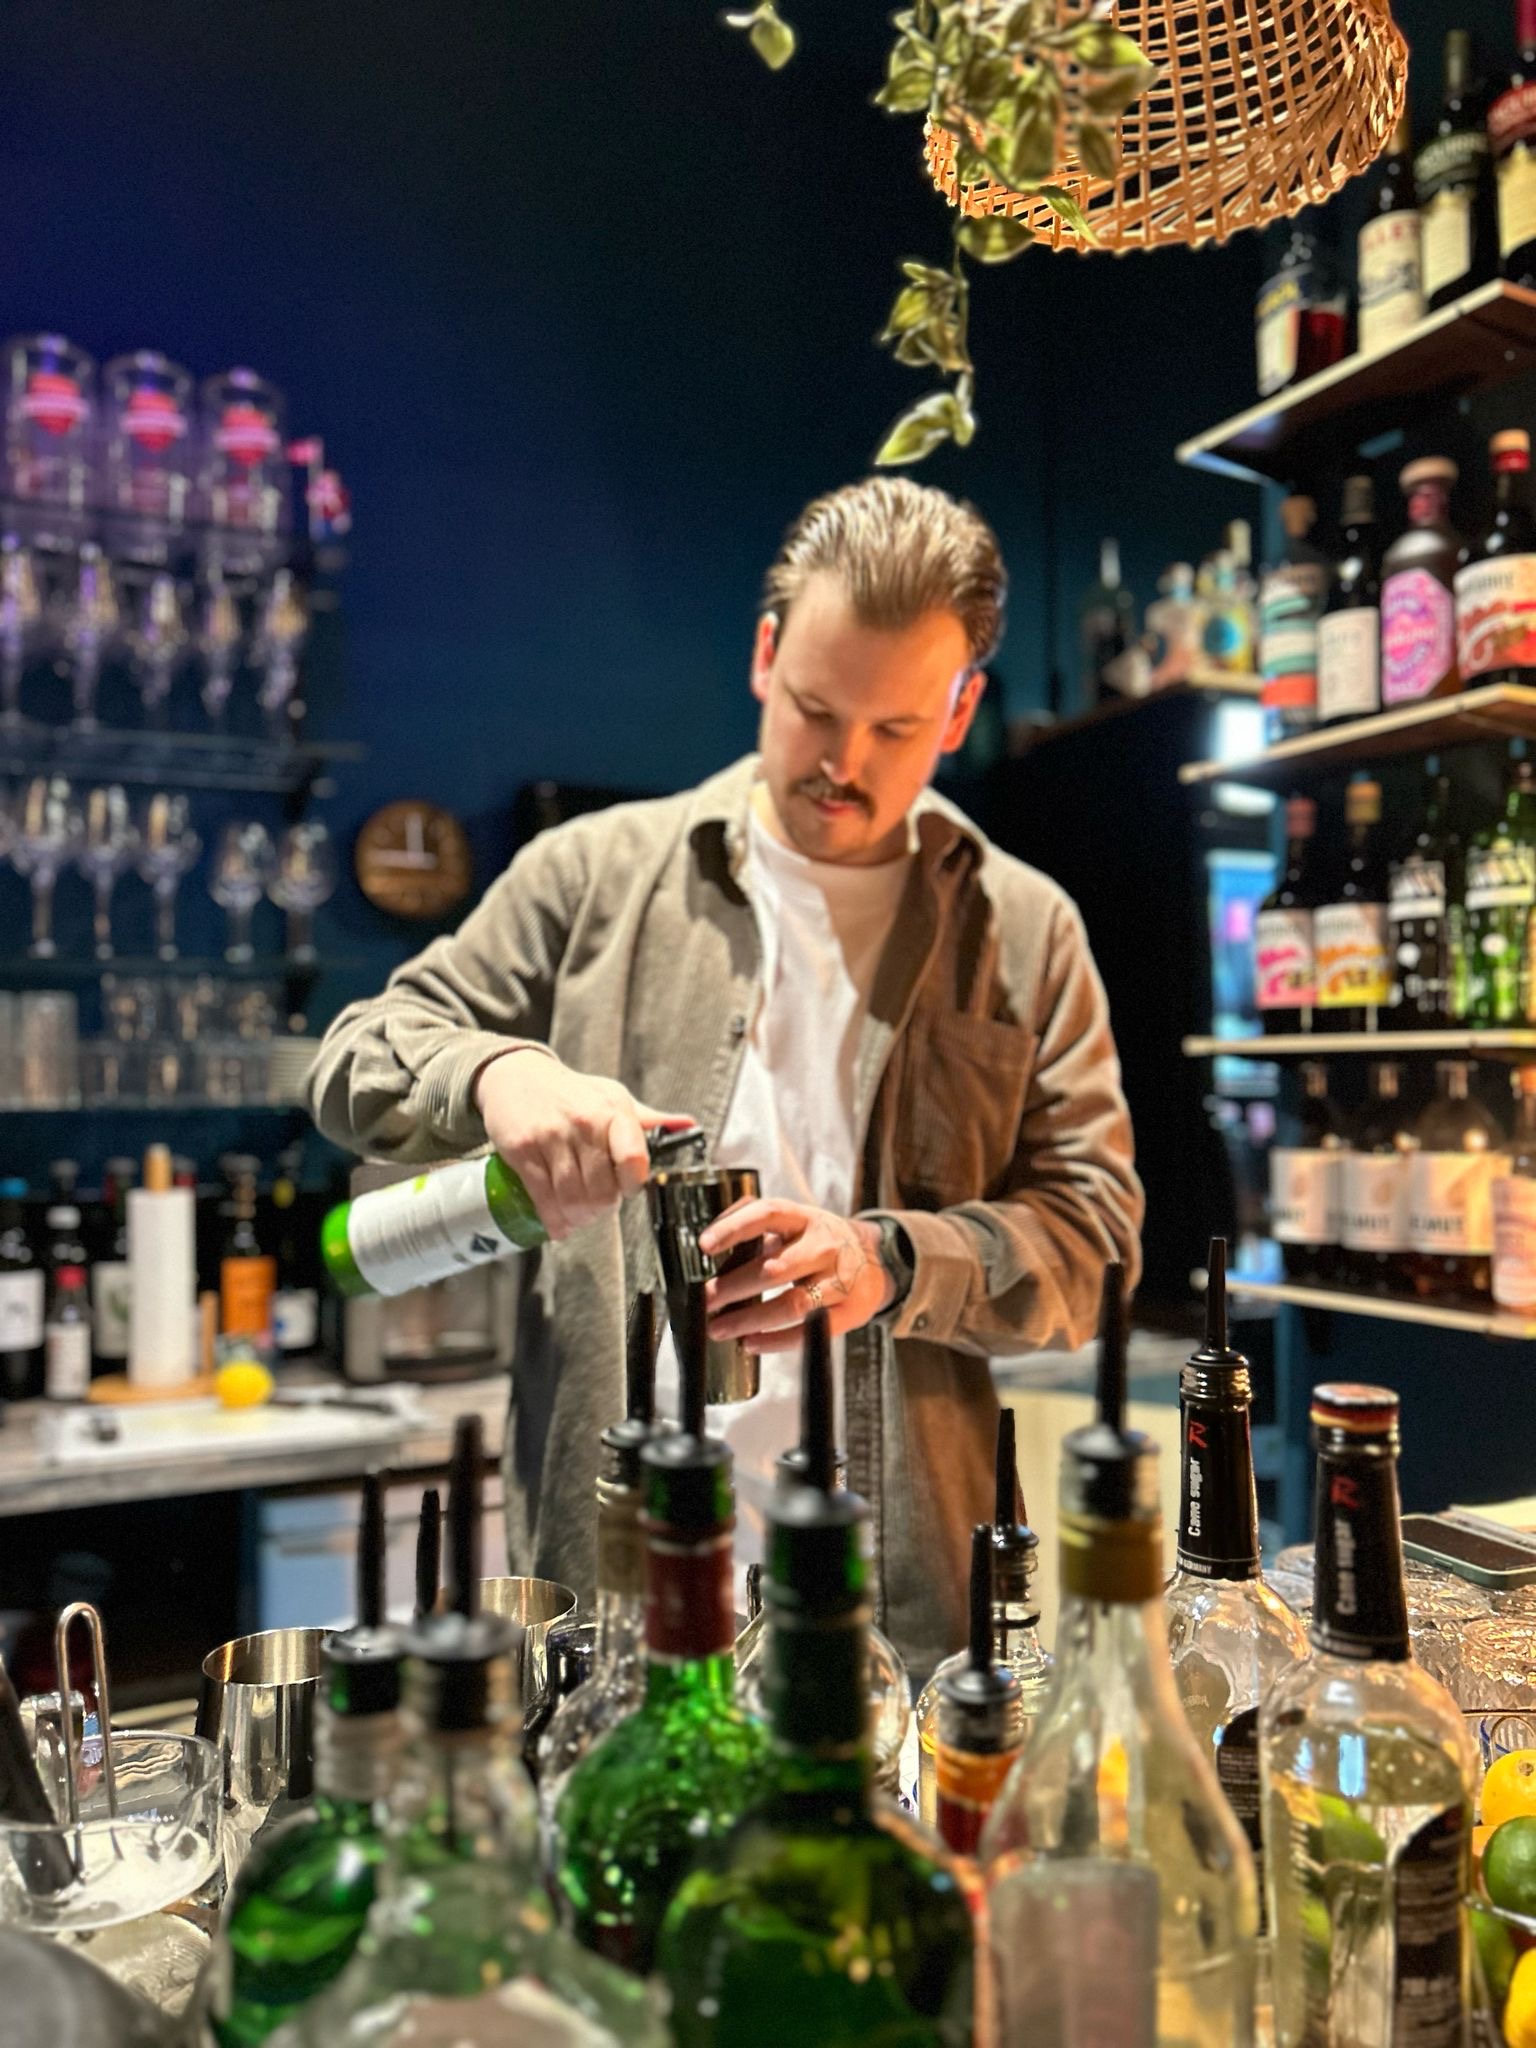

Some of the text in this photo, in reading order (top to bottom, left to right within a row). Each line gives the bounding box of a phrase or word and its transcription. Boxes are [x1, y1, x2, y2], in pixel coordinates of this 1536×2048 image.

[1189, 1421, 1208, 1448] R
[1188, 1457, 1203, 1537] Cane sugar
